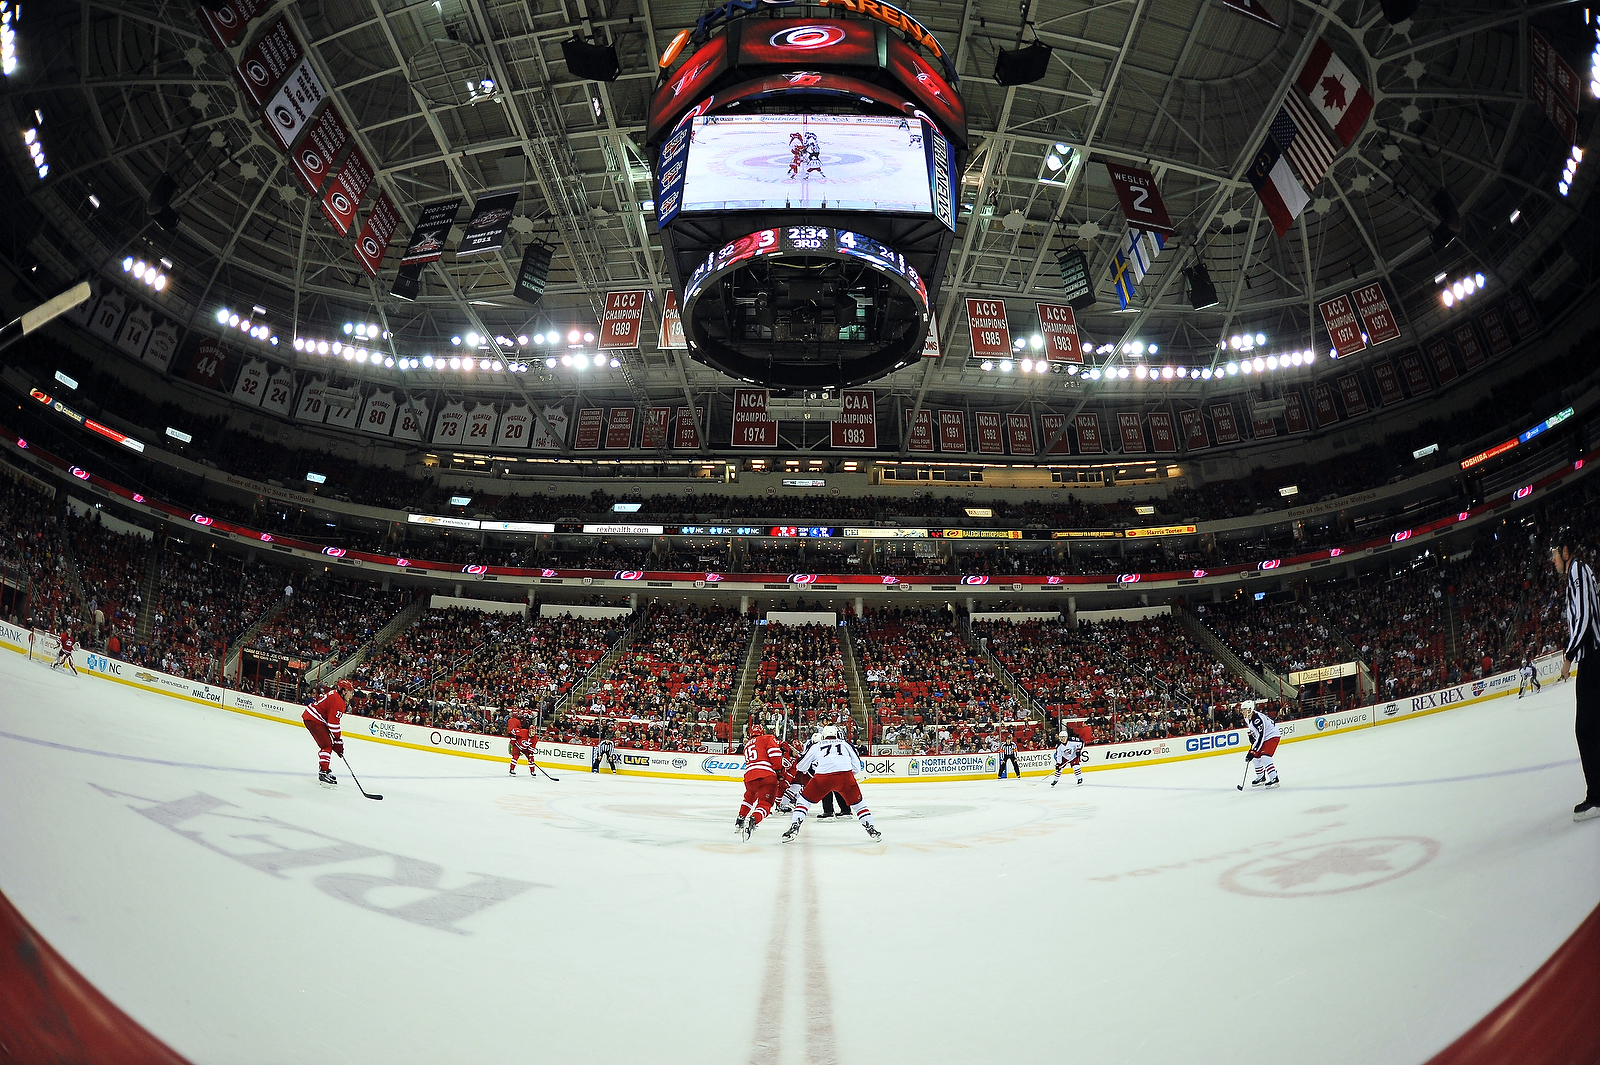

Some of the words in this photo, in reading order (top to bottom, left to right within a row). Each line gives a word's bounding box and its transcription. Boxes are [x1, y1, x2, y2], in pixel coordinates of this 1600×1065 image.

[272, 32, 290, 61] EASTERN
[277, 21, 297, 59] 2005-2006
[258, 42, 281, 79] CHAMPIONS
[264, 35, 287, 72] CONFERENCE
[295, 90, 305, 104] CUP
[297, 76, 314, 103] STANLEY
[284, 86, 306, 122] CHAMPIONS
[324, 108, 346, 142] 2005-2006
[317, 126, 336, 154] DIVISION
[319, 117, 342, 149] SOUTHEAST
[310, 131, 333, 164] CHAMPIONS
[349, 151, 371, 182] 2001-2002
[343, 169, 362, 195] DIVISION
[345, 159, 367, 190] SOUTHEAST
[1114, 172, 1151, 186] WESLEY
[337, 173, 359, 205] CHAMPIONS
[1129, 185, 1153, 214] 2
[372, 214, 389, 239] DIVISION
[374, 204, 393, 234] SOUTHEAST
[367, 218, 387, 248] CHAMPIONS
[758, 230, 775, 248] 3
[788, 228, 829, 240] 2:34
[840, 231, 857, 248] 4
[793, 239, 822, 249] 3RD
[718, 244, 735, 260] 32
[879, 245, 896, 262] 24
[613, 294, 636, 307] ACC
[1360, 288, 1378, 304] ACC
[606, 309, 640, 320] CHAMPIONS
[976, 303, 998, 315] ACC
[1046, 308, 1067, 321] ACC
[1327, 300, 1345, 317] ACC
[1361, 301, 1388, 317] CHAMPIONS
[100, 310, 115, 328] 10
[970, 317, 1006, 329] CHAMPIONS
[1327, 313, 1354, 331] CHAMPIONS
[1371, 315, 1388, 331] 1973
[127, 326, 142, 345] 14
[611, 322, 630, 335] 1989
[1042, 322, 1075, 334] CHAMPIONS
[1337, 327, 1354, 343] 1974
[980, 331, 1001, 346] 1985
[1052, 337, 1072, 351] 1983
[199, 346, 226, 362] THOMPSON
[196, 356, 217, 377] 44
[241, 378, 259, 396] 32
[270, 388, 287, 405] 24
[303, 397, 321, 413] 70
[371, 400, 390, 410] SPEIGHT
[1213, 407, 1231, 418] NCAA
[369, 409, 386, 425] 80
[402, 416, 418, 432] 84
[942, 413, 961, 424] NCAA
[979, 416, 997, 427] NCAA
[1010, 417, 1028, 428] NCAA
[1045, 417, 1063, 428] NCAA
[1078, 416, 1096, 427] NCAA
[1120, 416, 1138, 427] NCAA
[1151, 416, 1169, 427] NCAA
[440, 422, 458, 437] 73
[470, 423, 488, 438] 24
[504, 424, 522, 439] 20
[681, 429, 694, 439] 1973
[743, 427, 765, 442] 1974
[842, 429, 865, 444] 1983
[946, 427, 959, 438] 1951
[983, 429, 997, 440] 1952
[1461, 453, 1488, 469] TOSHIBA
[262, 486, 273, 495] NC
[272, 489, 287, 498] State
[289, 492, 316, 504] Wolfpack
[597, 525, 649, 534] rexhealth.com
[962, 530, 980, 538] RALEIGH
[980, 530, 1008, 538] ORTHOPAEDIC
[108, 662, 122, 675] NC
[160, 679, 190, 690] CHEVROLET
[1489, 678, 1501, 687] AUTO
[1502, 674, 1517, 684] PARTS
[192, 689, 221, 702] NHL.COM
[1411, 696, 1438, 712] REX
[1440, 687, 1465, 703] REX
[261, 702, 284, 712] CHEROKEE
[380, 722, 395, 731] DUKE
[379, 731, 403, 740] ENERGY
[444, 735, 490, 750] QUINTILES
[1186, 732, 1240, 752] GEICO
[553, 748, 585, 760] DEERE
[820, 744, 843, 757] 71
[1105, 749, 1152, 760] lenovo
[624, 756, 649, 765] LIVE
[709, 761, 740, 770] BUD
[865, 759, 896, 774] belk
[922, 758, 946, 767] NORTH
[948, 757, 984, 766] CAROLINA
[956, 764, 984, 772] LOTTERY
